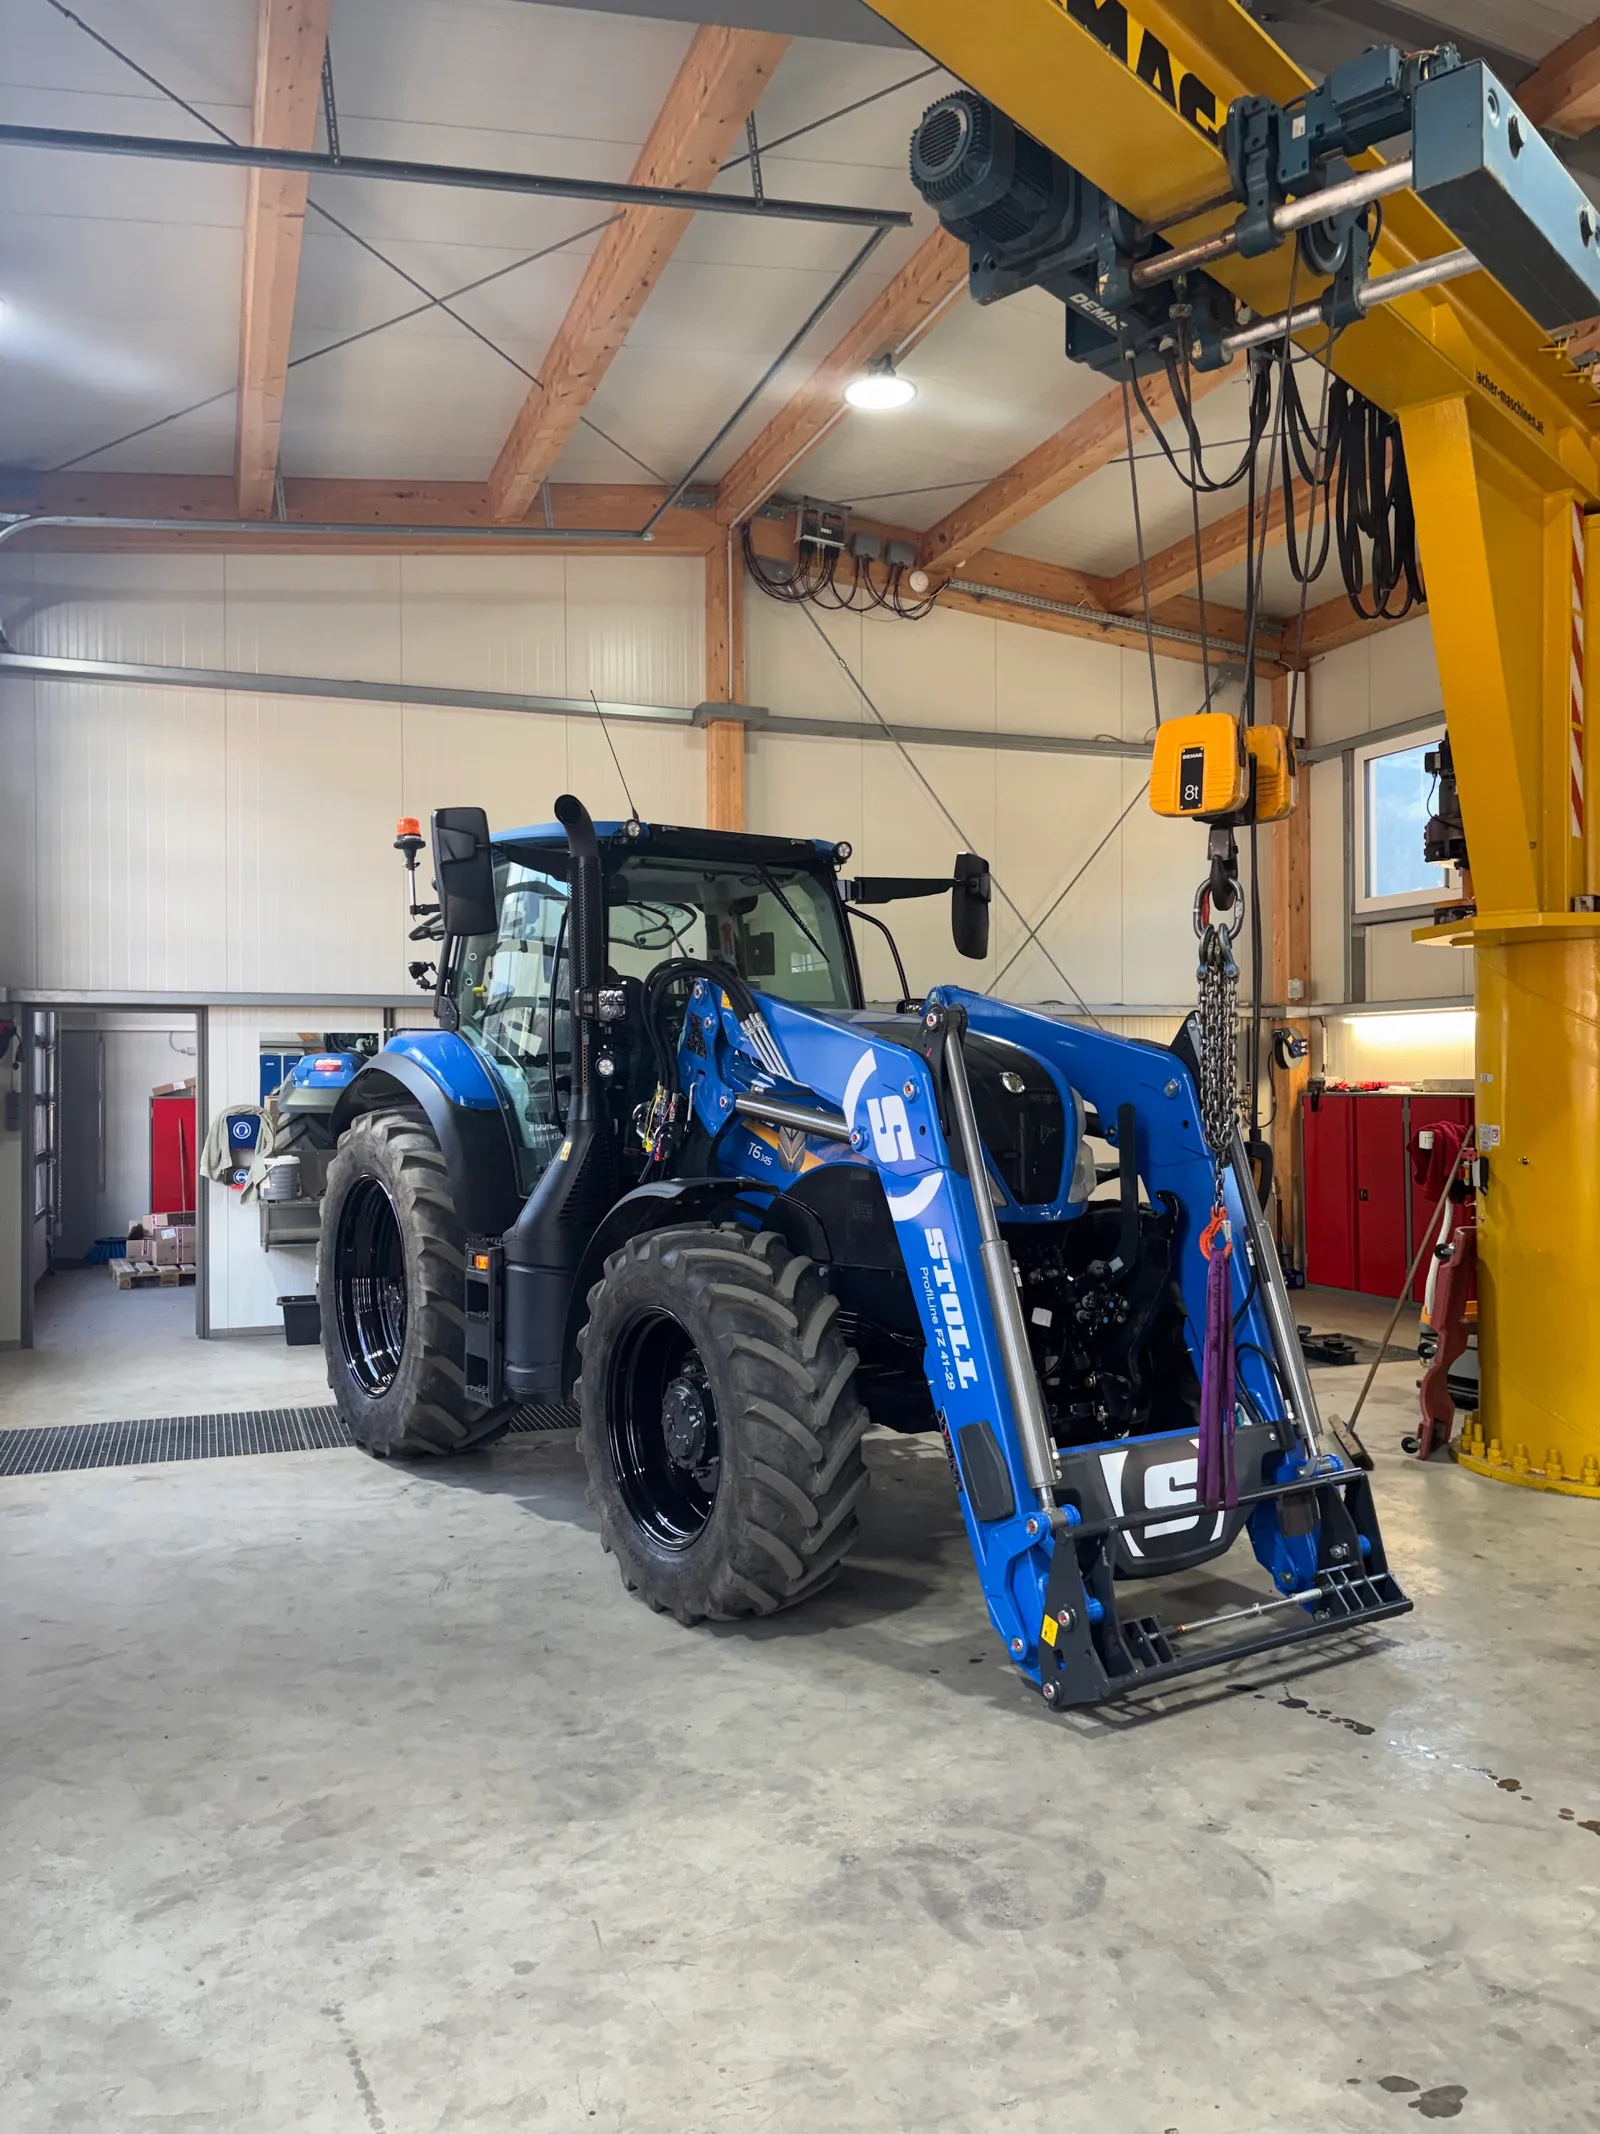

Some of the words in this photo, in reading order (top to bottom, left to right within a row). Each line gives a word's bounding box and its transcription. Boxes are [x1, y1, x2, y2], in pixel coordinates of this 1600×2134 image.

[1056, 0, 1219, 147] MAG
[1476, 367, 1544, 435] acher-maschinen.at
[1184, 784, 1199, 800] 8t
[920, 1266, 939, 1325] ProfiLine
[924, 1228, 978, 1389] STOLL
[934, 1328, 947, 1348] FZ
[940, 1350, 956, 1391] 41-29
